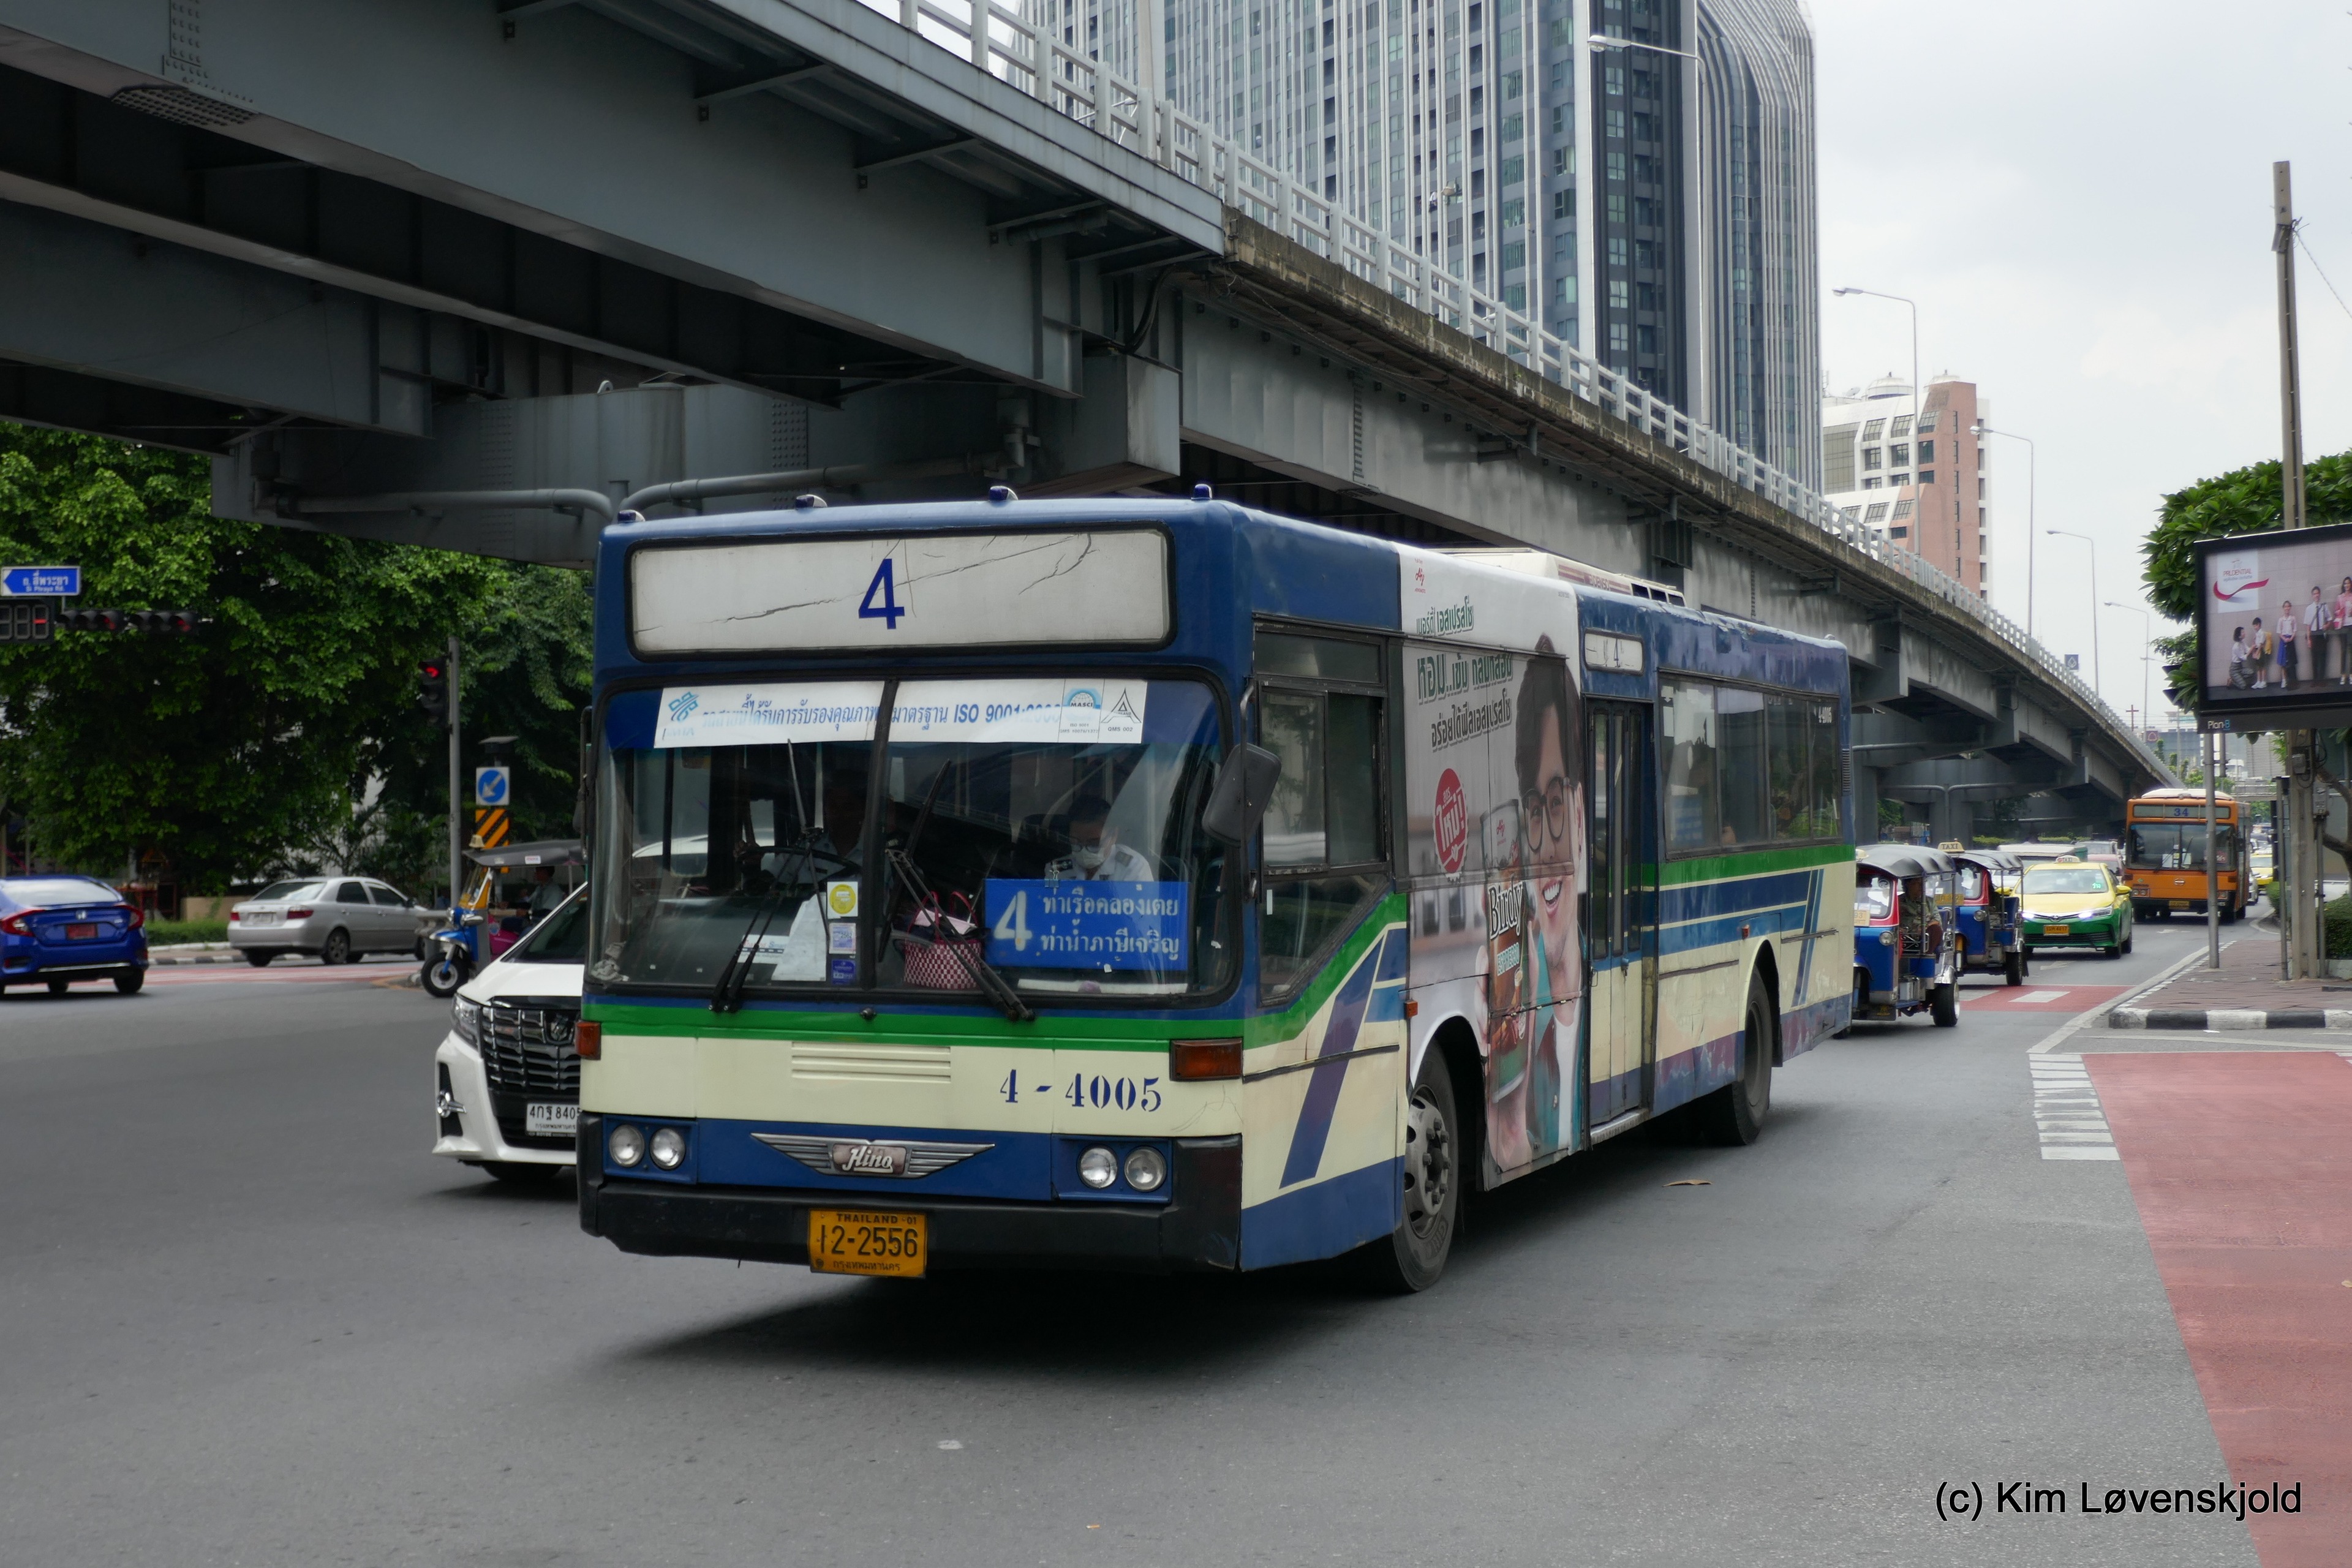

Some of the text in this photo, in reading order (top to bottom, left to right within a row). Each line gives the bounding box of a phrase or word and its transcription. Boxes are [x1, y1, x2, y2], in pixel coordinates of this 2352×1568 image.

[858, 559, 905, 630] 4
[1472, 652, 1513, 686] กลมกลอม
[891, 706, 948, 731] มาตรฐาน
[954, 703, 979, 723] ISO
[2174, 807, 2189, 817] 34
[1043, 886, 1178, 916] ท่าเรือคลองเตย
[1488, 874, 1523, 938] Birdy
[993, 890, 1033, 951] 4
[1497, 942, 1520, 976] ESPRESSO
[1000, 1069, 1018, 1103] 4
[1065, 1073, 1161, 1112] 4005
[842, 1145, 894, 1174] Hino
[837, 1213, 898, 1224] THAILAND
[821, 1225, 918, 1257] 12-2556
[833, 1259, 900, 1272] กรุงเทพมหานคร
